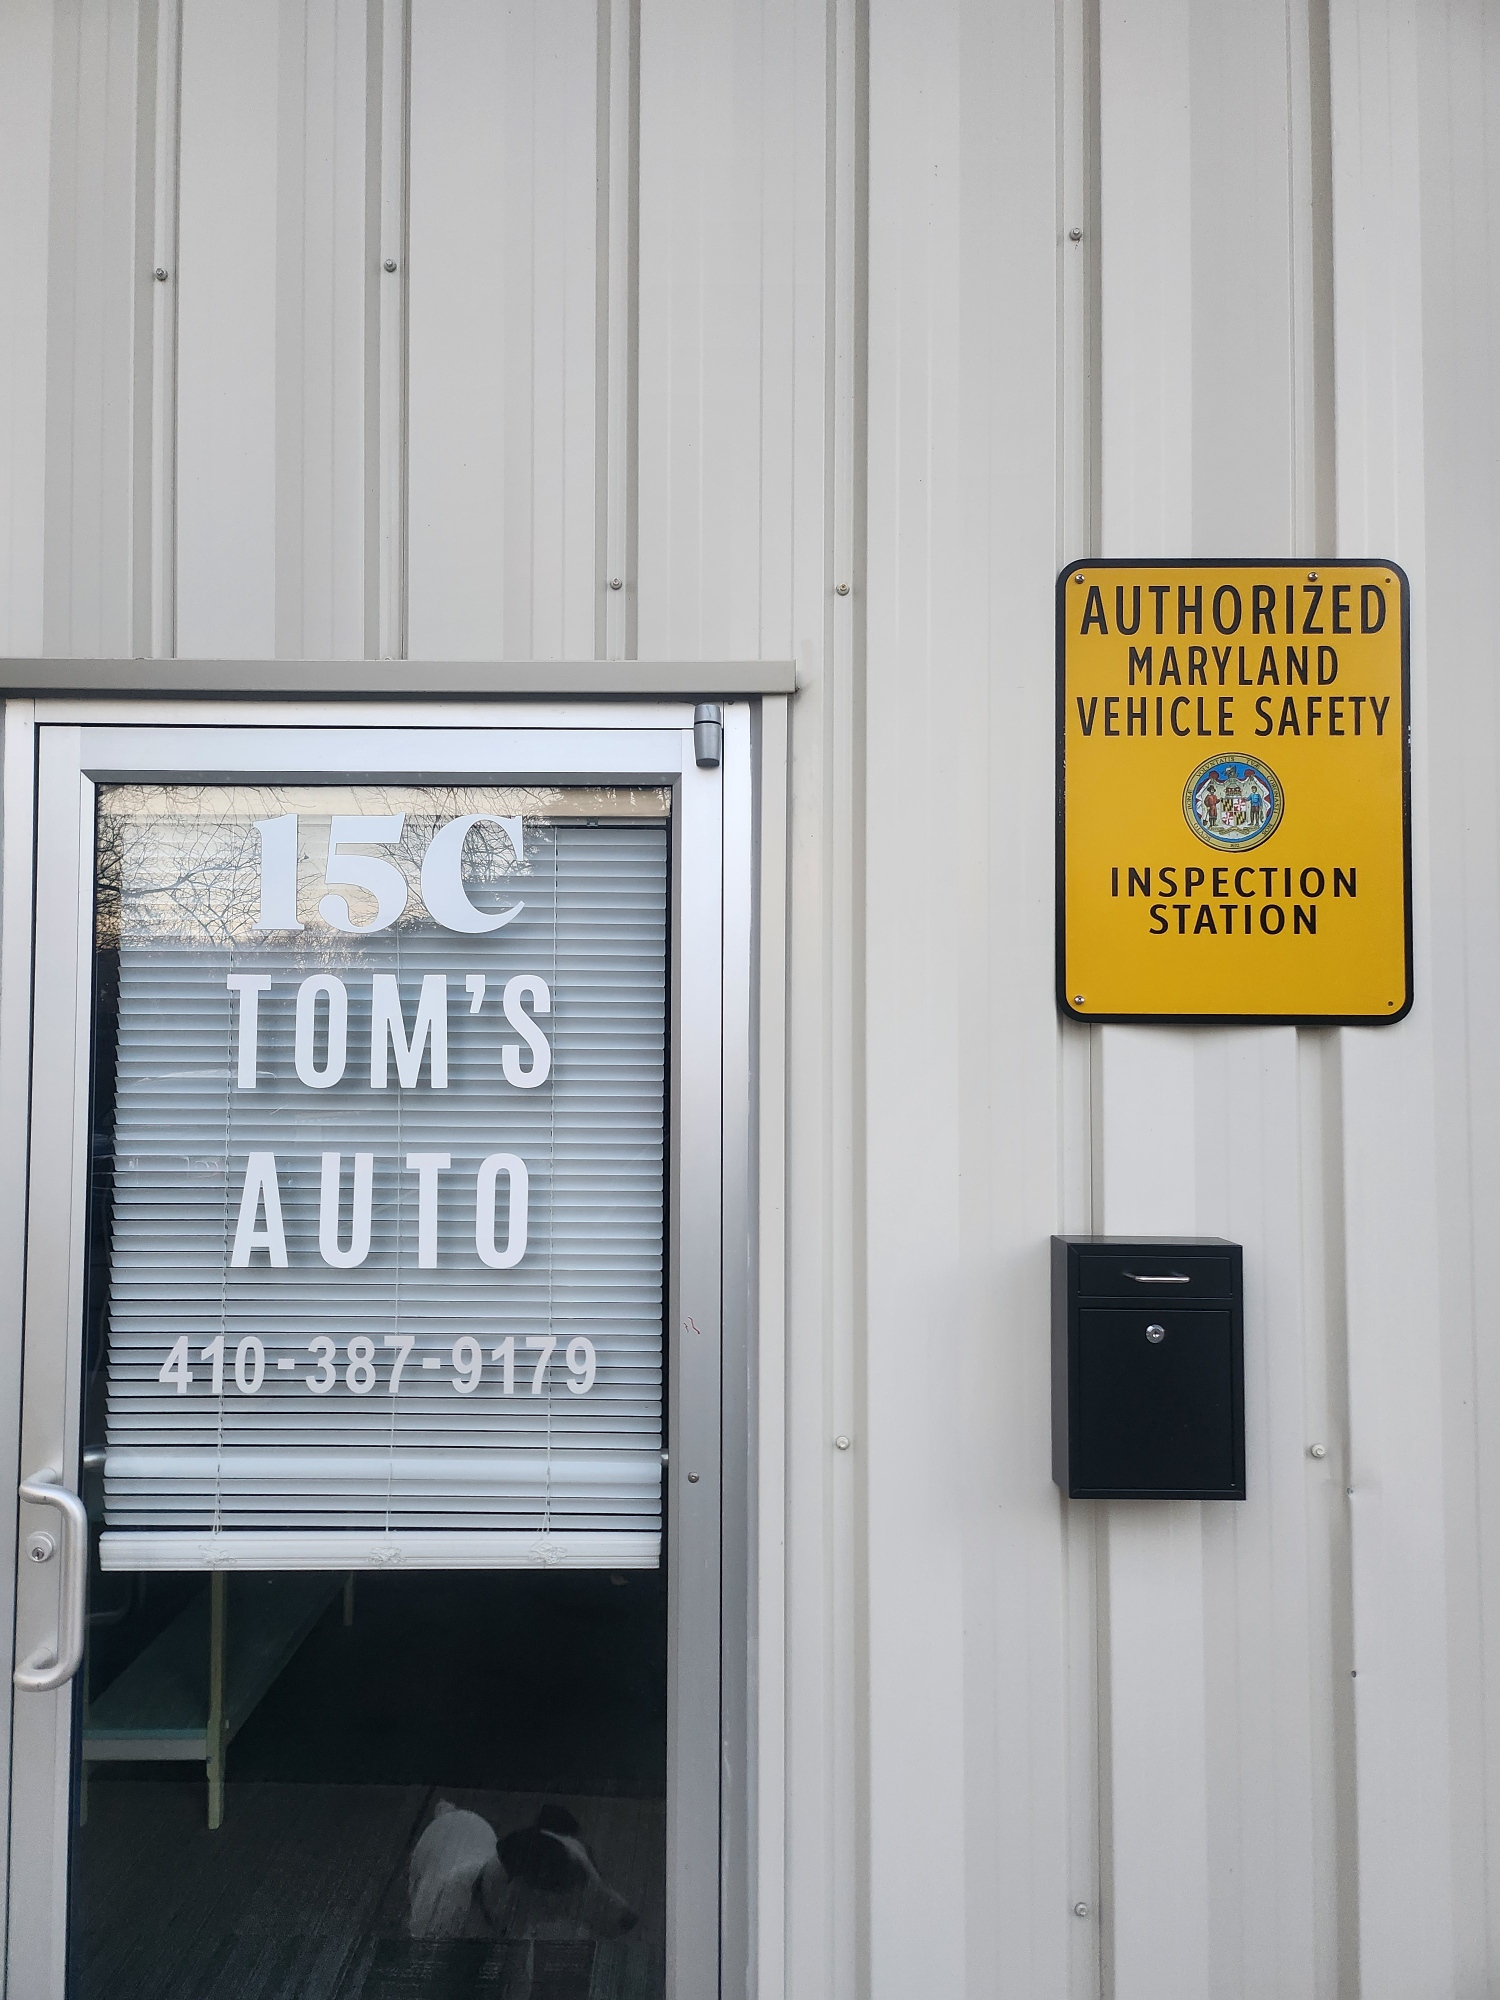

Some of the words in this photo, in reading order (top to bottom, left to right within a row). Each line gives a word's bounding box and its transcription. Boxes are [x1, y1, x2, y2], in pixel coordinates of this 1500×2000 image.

[1080, 584, 1386, 635] AUTHORIZED
[1128, 646, 1338, 686] MARYLAND
[1076, 696, 1233, 736] VEHICLE
[1255, 696, 1390, 736] SAFETY
[251, 812, 525, 933] 15C
[1111, 867, 1356, 897] INSPECTION
[1149, 904, 1317, 934] STATION
[230, 1152, 529, 1269] AUTO
[159, 1335, 597, 1394] 410-387-9179
